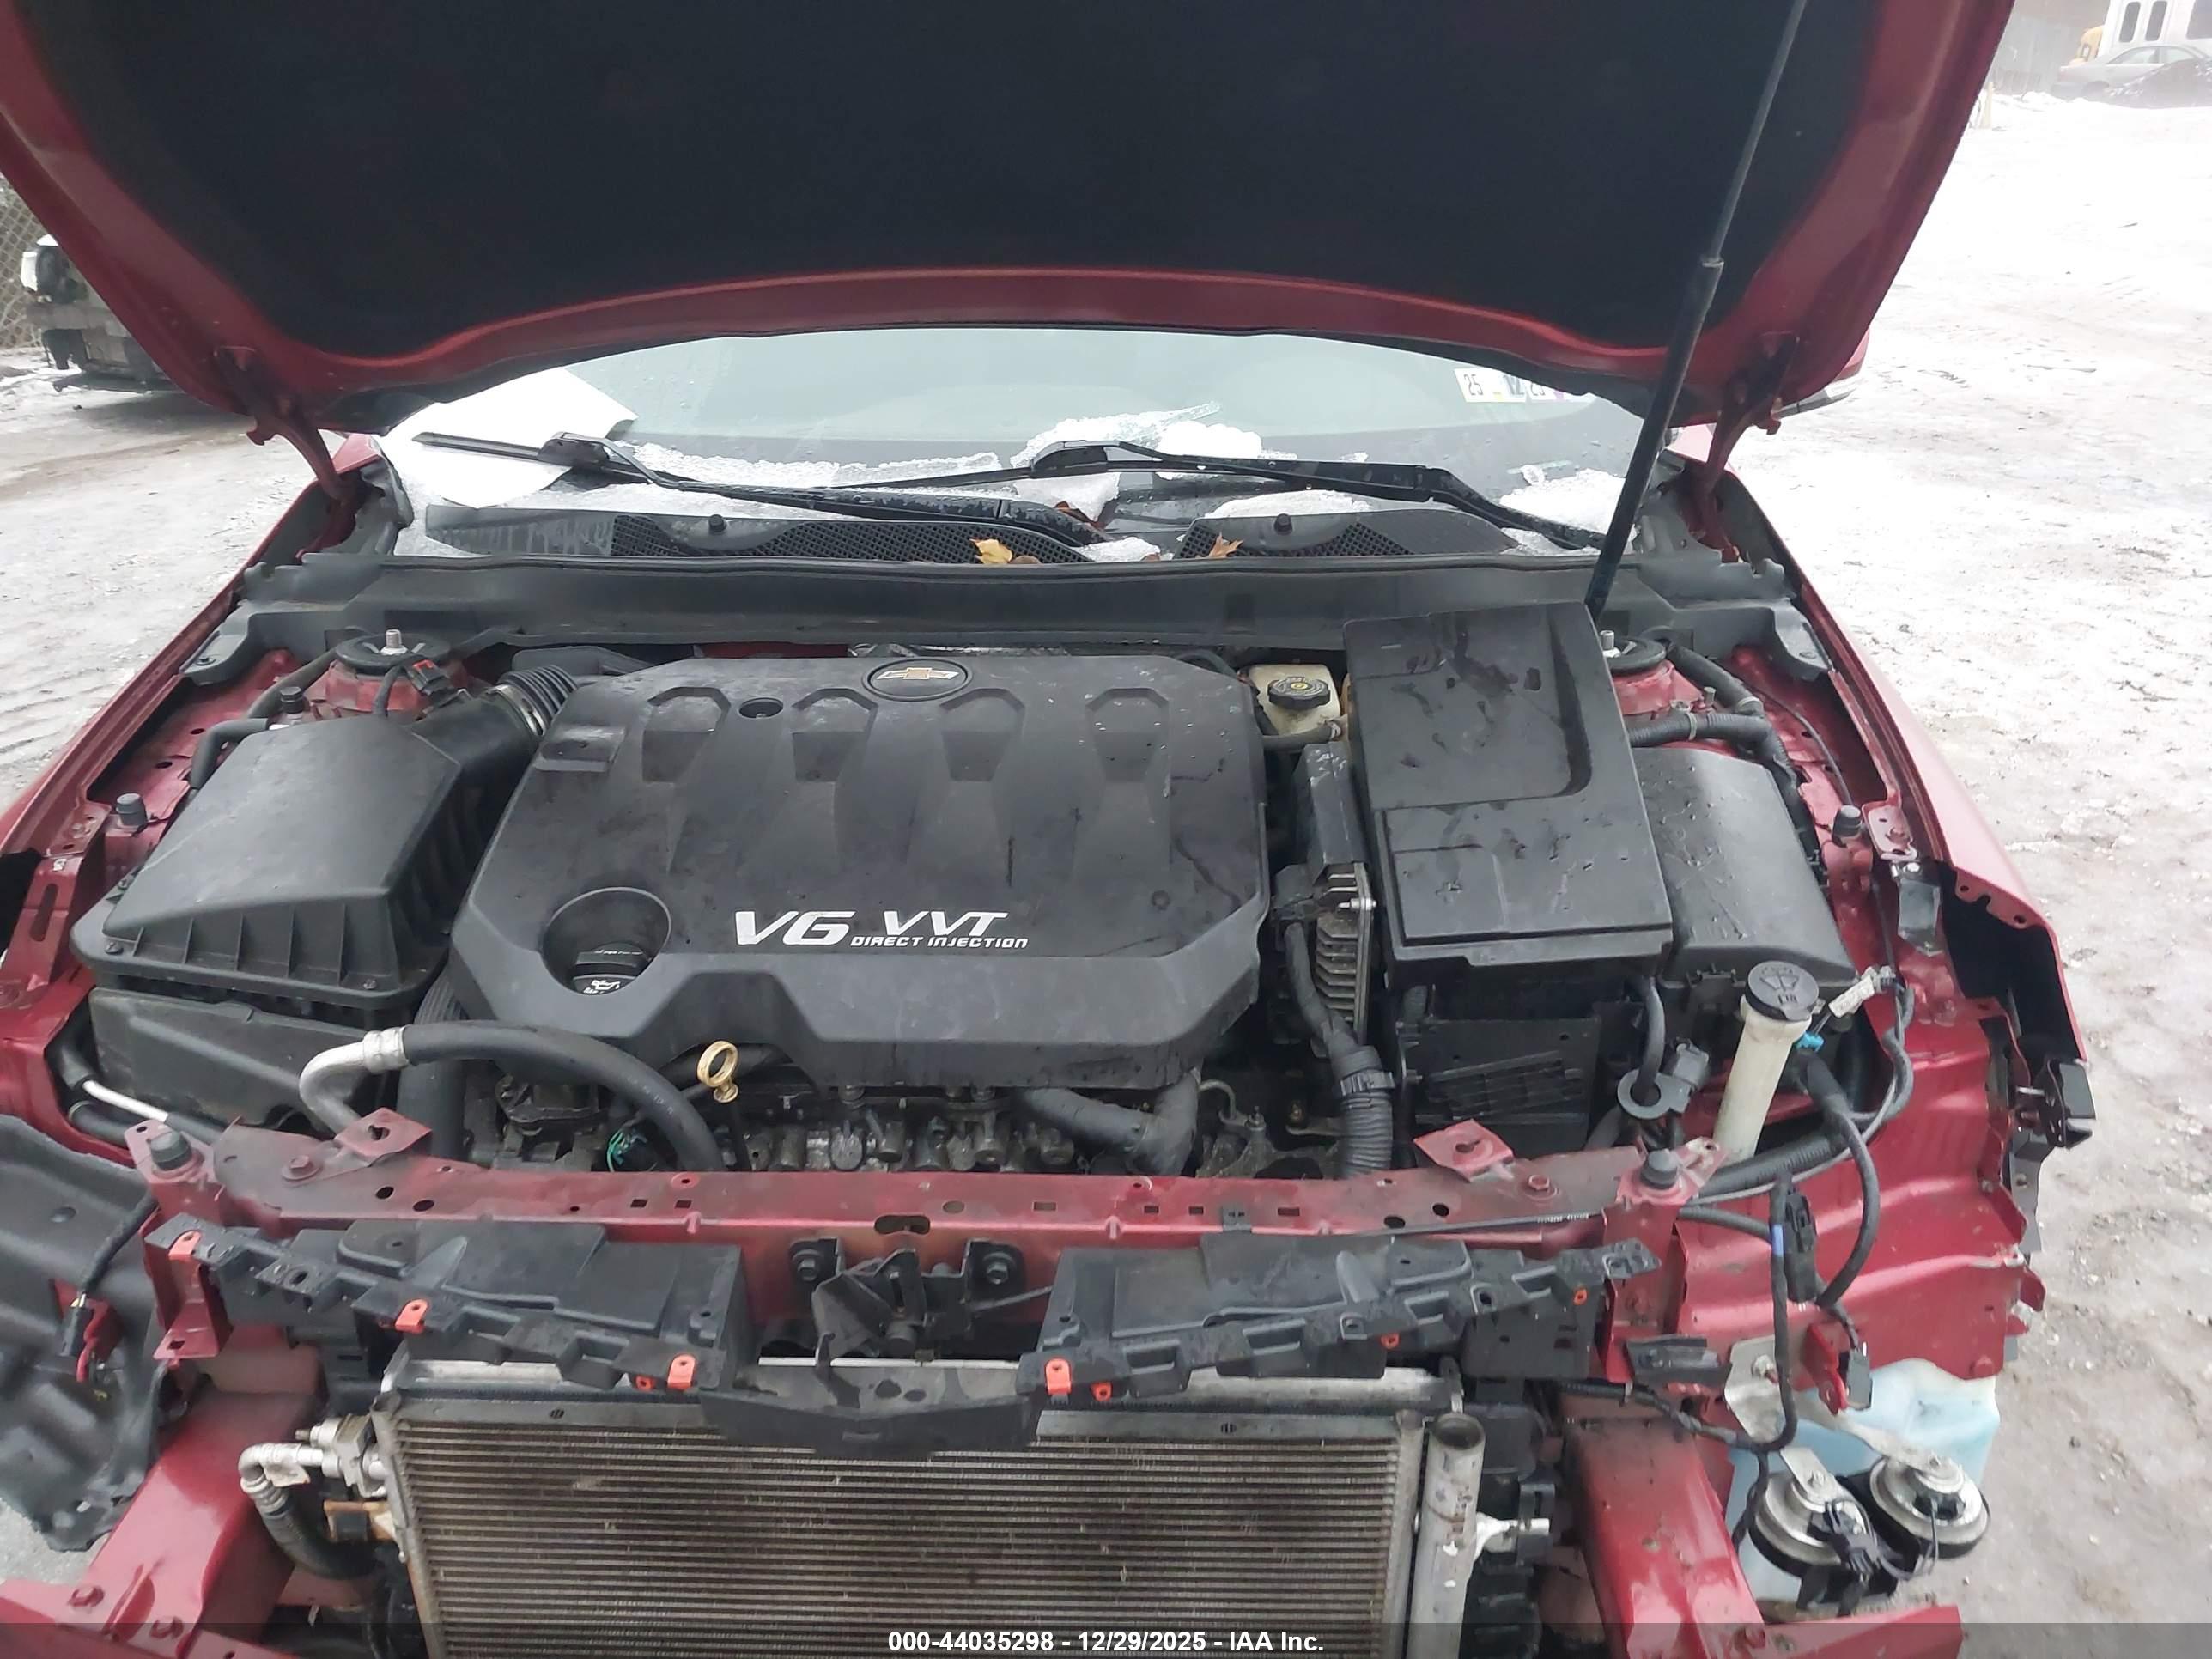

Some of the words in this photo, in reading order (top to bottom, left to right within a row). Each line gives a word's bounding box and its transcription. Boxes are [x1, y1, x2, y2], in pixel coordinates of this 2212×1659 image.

[1463, 374, 1484, 396] 25
[734, 910, 856, 945] V6
[882, 910, 1009, 936] VVT
[849, 935, 924, 948] DIRECT
[927, 937, 1029, 949] INJECTION
